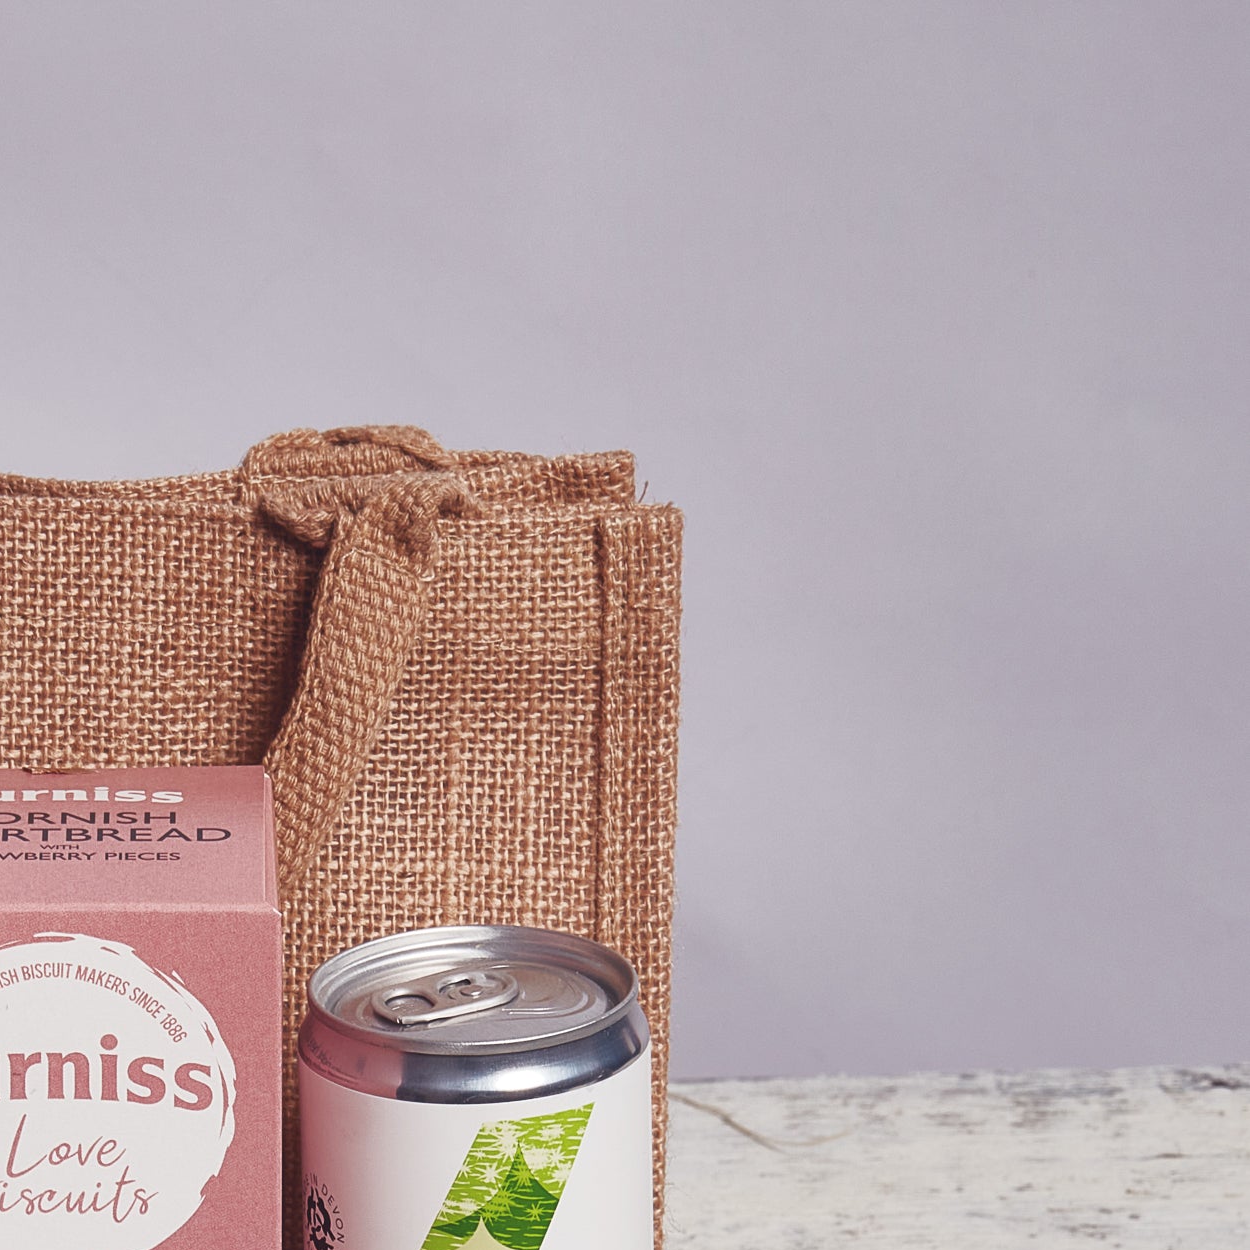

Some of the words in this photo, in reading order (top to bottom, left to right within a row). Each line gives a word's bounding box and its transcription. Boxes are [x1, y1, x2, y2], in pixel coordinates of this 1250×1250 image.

[104, 852, 181, 861] PIECES
[21, 962, 73, 981] BISCUIT
[75, 965, 130, 996] MAKERS
[128, 987, 166, 1020] SINCE
[159, 1013, 189, 1044] 1886
[6, 1113, 127, 1178] Love
[321, 1183, 345, 1244] DEVON
